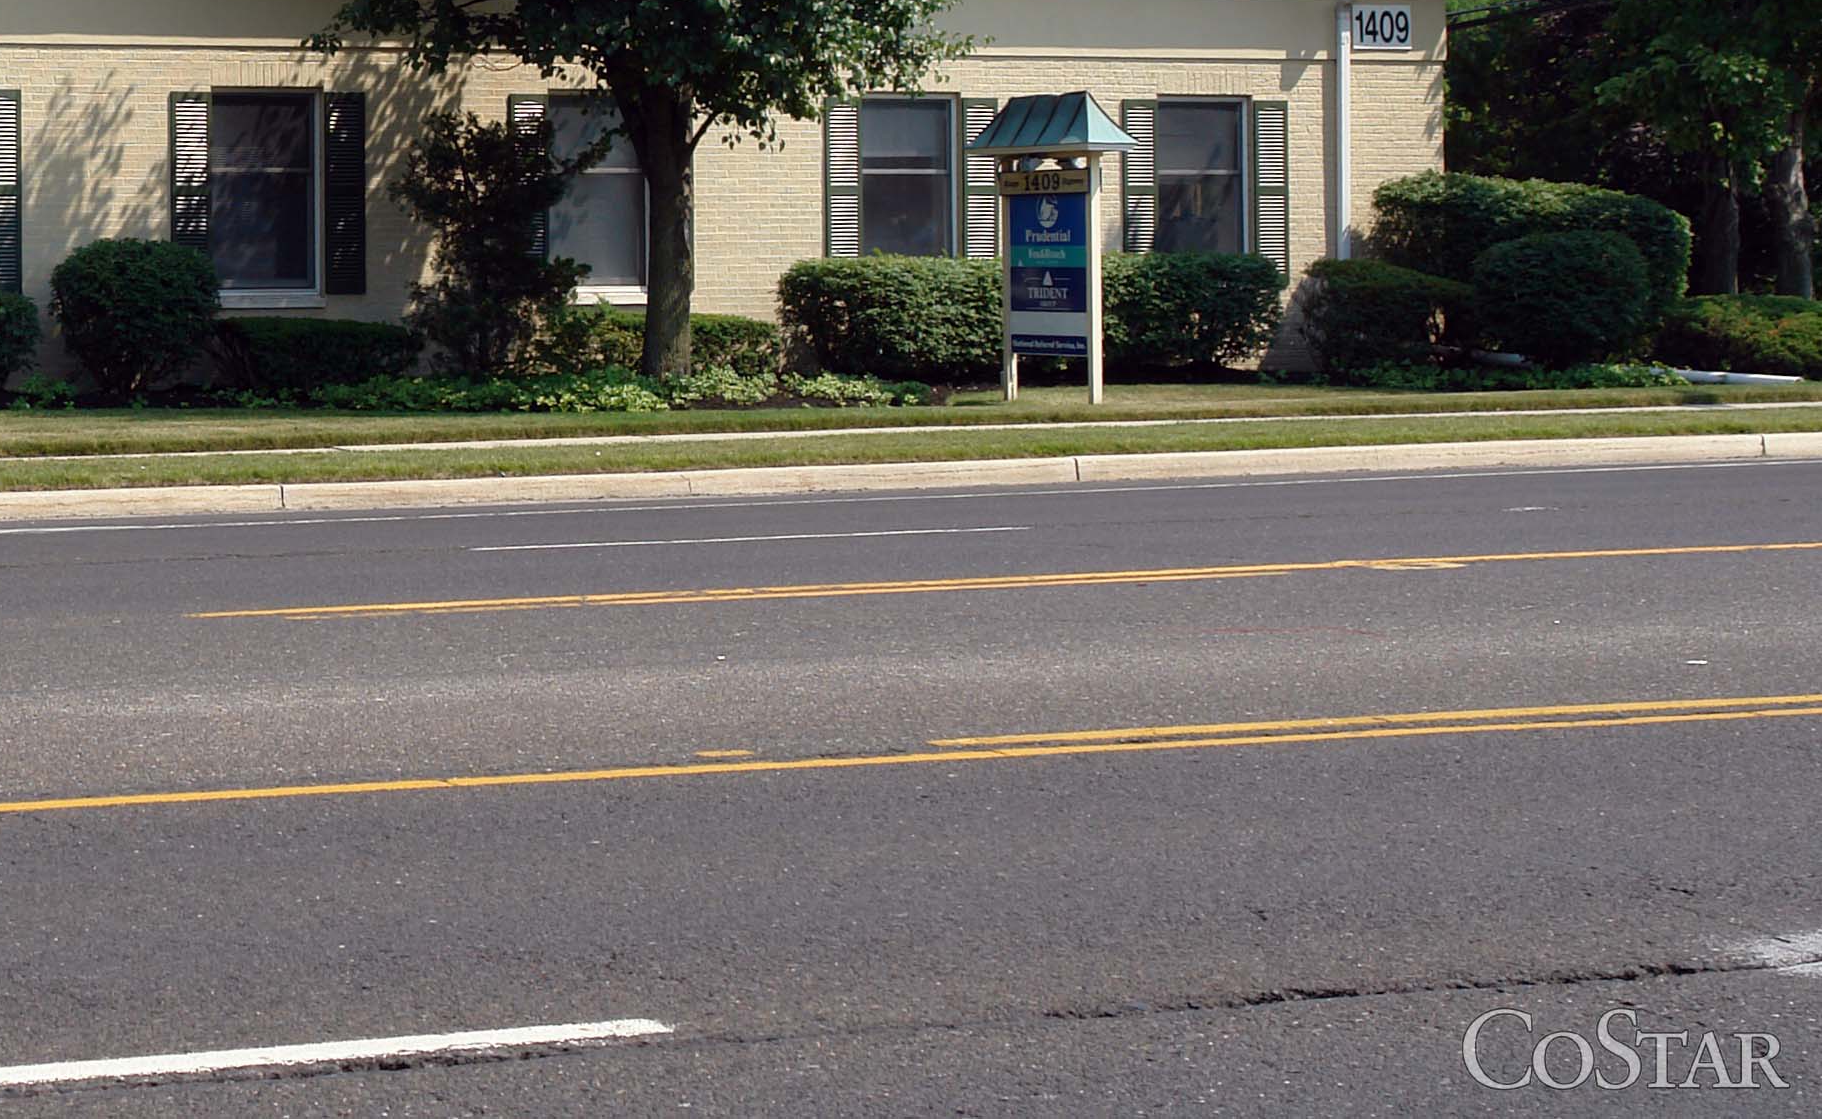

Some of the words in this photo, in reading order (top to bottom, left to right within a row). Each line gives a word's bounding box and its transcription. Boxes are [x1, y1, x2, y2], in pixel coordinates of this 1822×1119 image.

[1355, 10, 1409, 43] 1409
[1024, 173, 1060, 191] 1409
[1025, 229, 1071, 242] Prudential
[1027, 287, 1069, 299] TRIDENT
